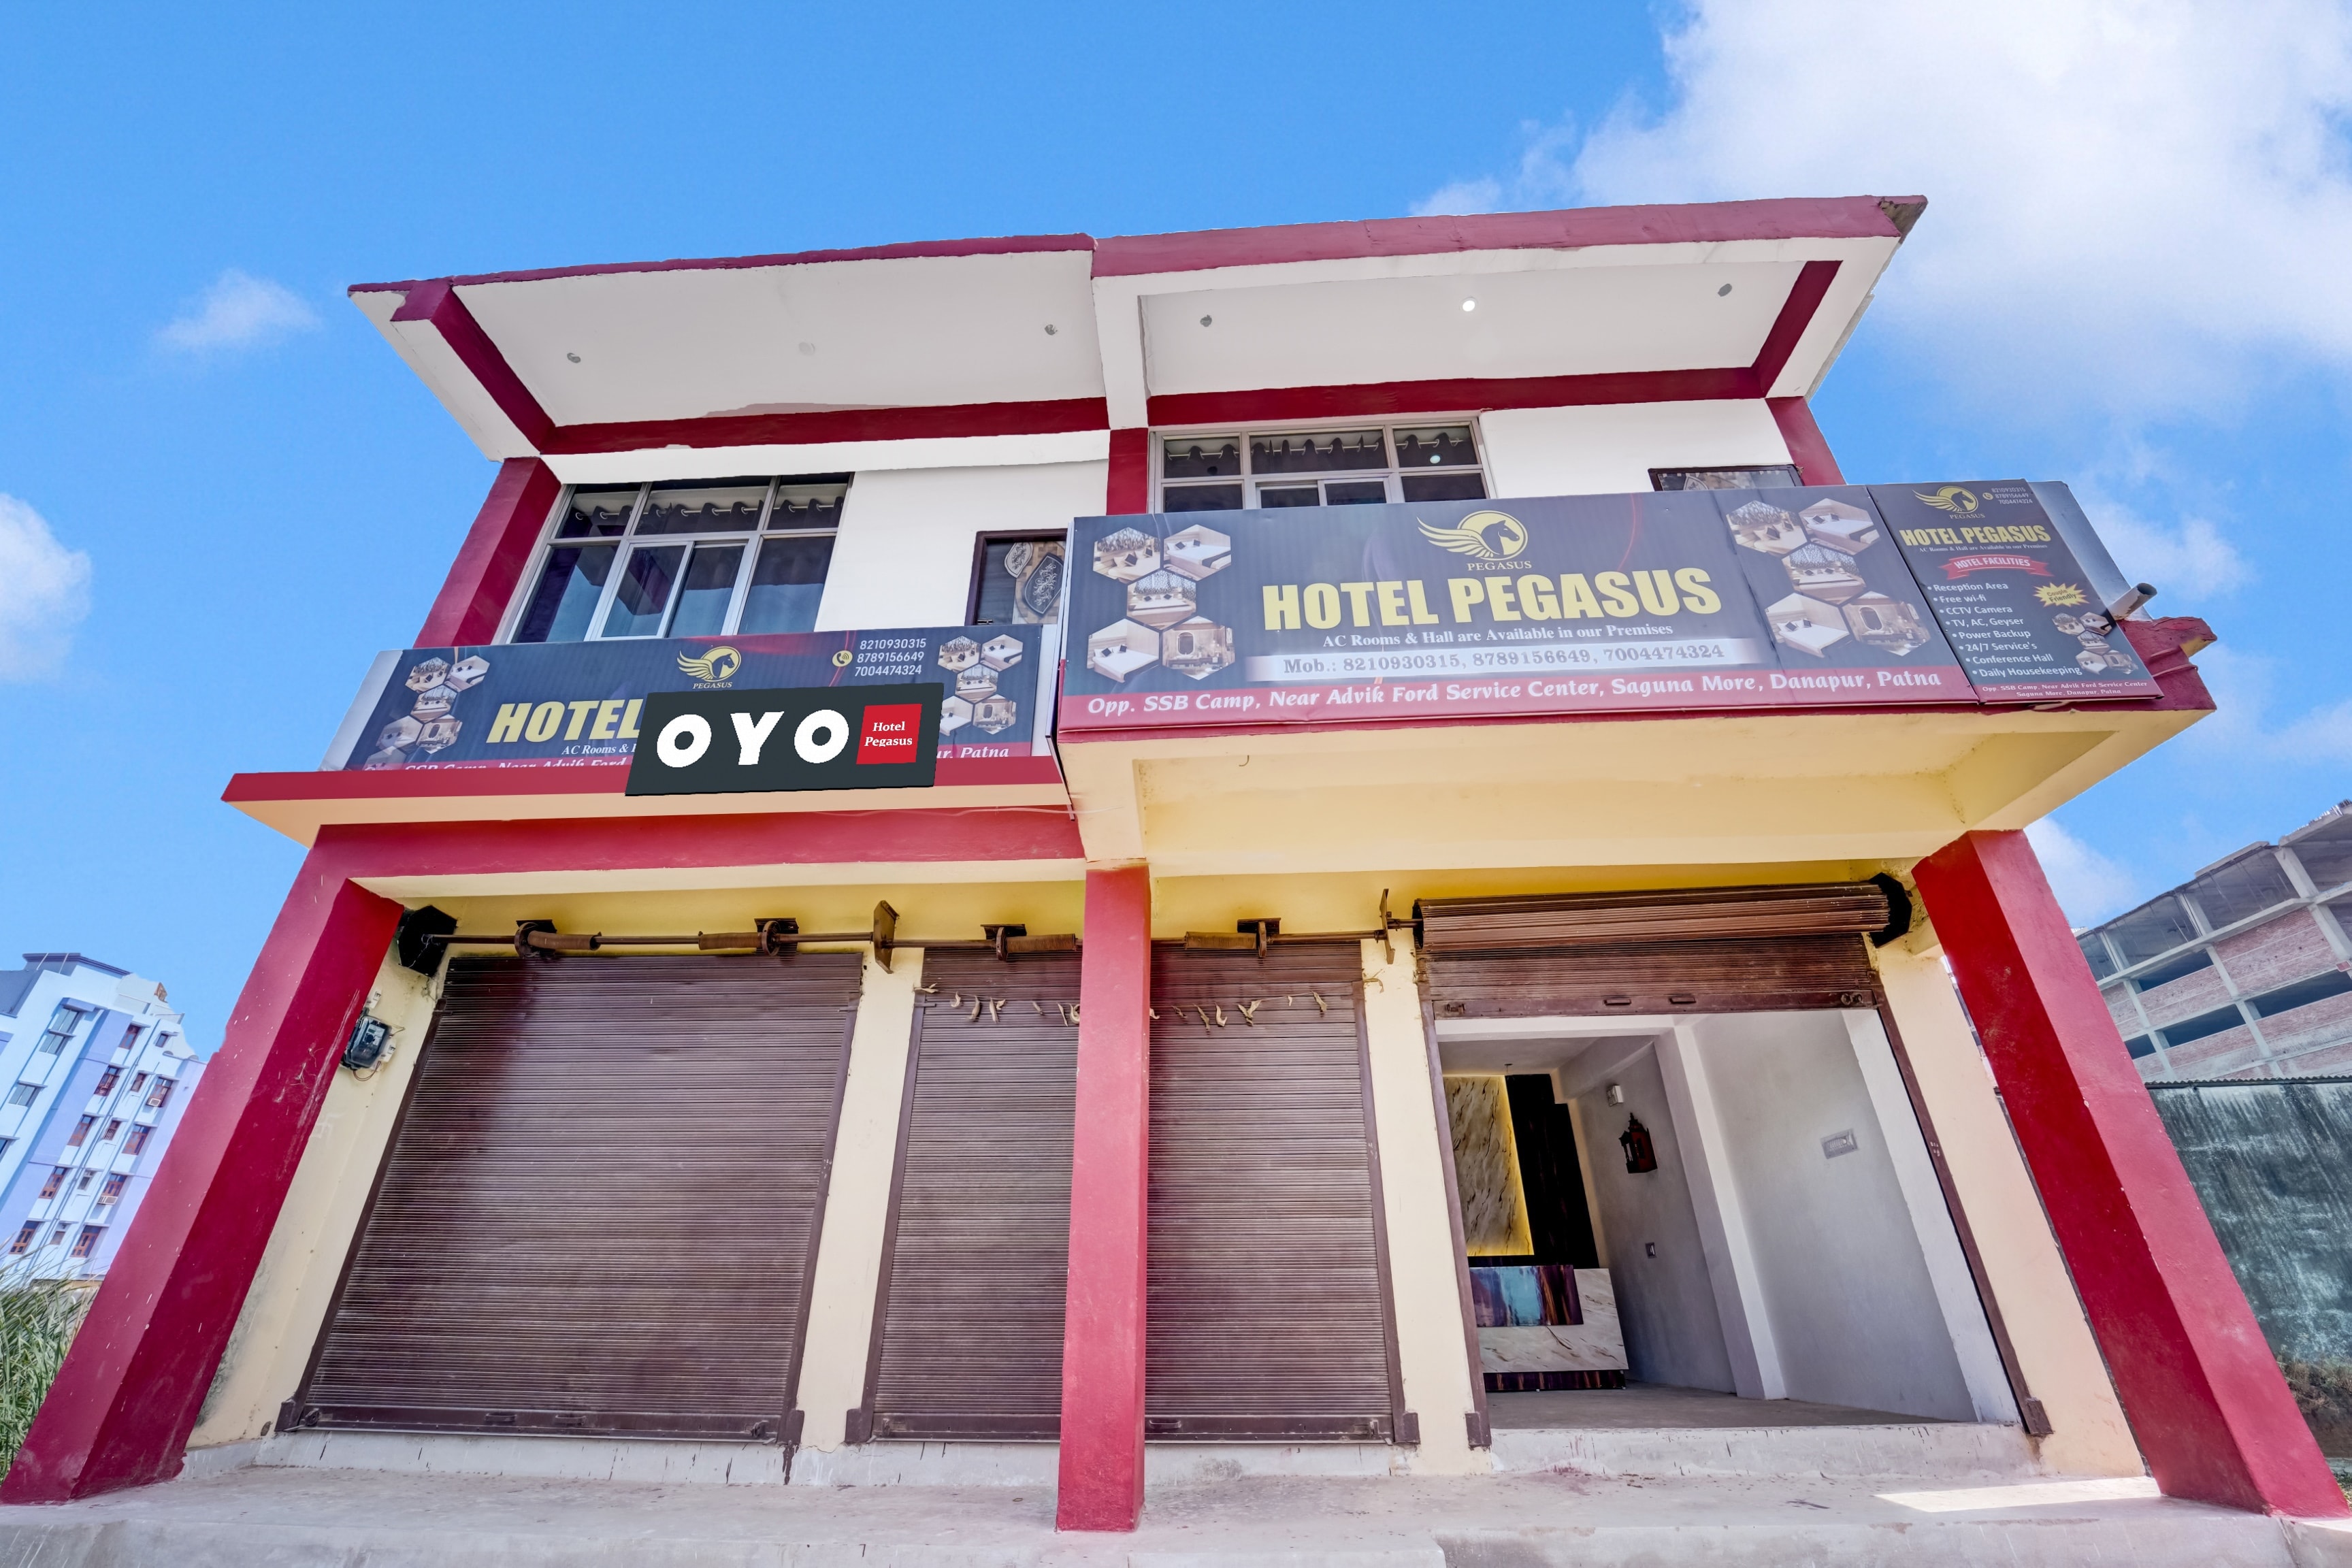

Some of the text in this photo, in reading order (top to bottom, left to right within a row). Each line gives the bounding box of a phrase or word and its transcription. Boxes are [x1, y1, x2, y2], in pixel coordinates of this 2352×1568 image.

[1899, 525, 2052, 546] HOTEL PEGASUS
[1467, 560, 1532, 571] PEGASUS
[1954, 557, 2031, 569] HOTEL FACILITIES
[1933, 582, 2009, 593] Reception Area
[1262, 567, 1722, 631] HOTEL PEGASUS
[1963, 594, 1987, 602] wi-fi
[2048, 593, 2077, 602] Friendly
[1946, 606, 2013, 615] CCTV Camera
[1950, 617, 2024, 628] TV, AC, Geyser
[1323, 623, 1673, 647] AC Rooms & Hall are Available in our Premises
[1958, 630, 2031, 640] Power Backup
[860, 638, 927, 650] 8210930315
[1965, 642, 2038, 653] 24/7 Service's
[857, 651, 925, 664] 8789156649
[1343, 654, 1467, 672] 8210930315,
[1472, 649, 1598, 667] 8789156649,
[1603, 644, 1725, 662] 7004474324
[1972, 653, 2054, 664] Conference Hall
[854, 664, 922, 676] 7004474324
[1978, 666, 2083, 678] Daily Housekeeping
[692, 681, 733, 689] PEGASUS
[1088, 670, 1942, 717] Opp. SSB Camp, Near Advik Ford Service Center, Saguna More, Danapur, Patna
[486, 698, 644, 744] HOTEL
[872, 721, 906, 732] Hotel
[657, 709, 849, 768] OYO
[864, 736, 913, 748] Pegasus
[561, 745, 581, 755] AC
[581, 745, 617, 755] Rooms
[619, 743, 630, 753] &
[960, 746, 1009, 758] Patna
